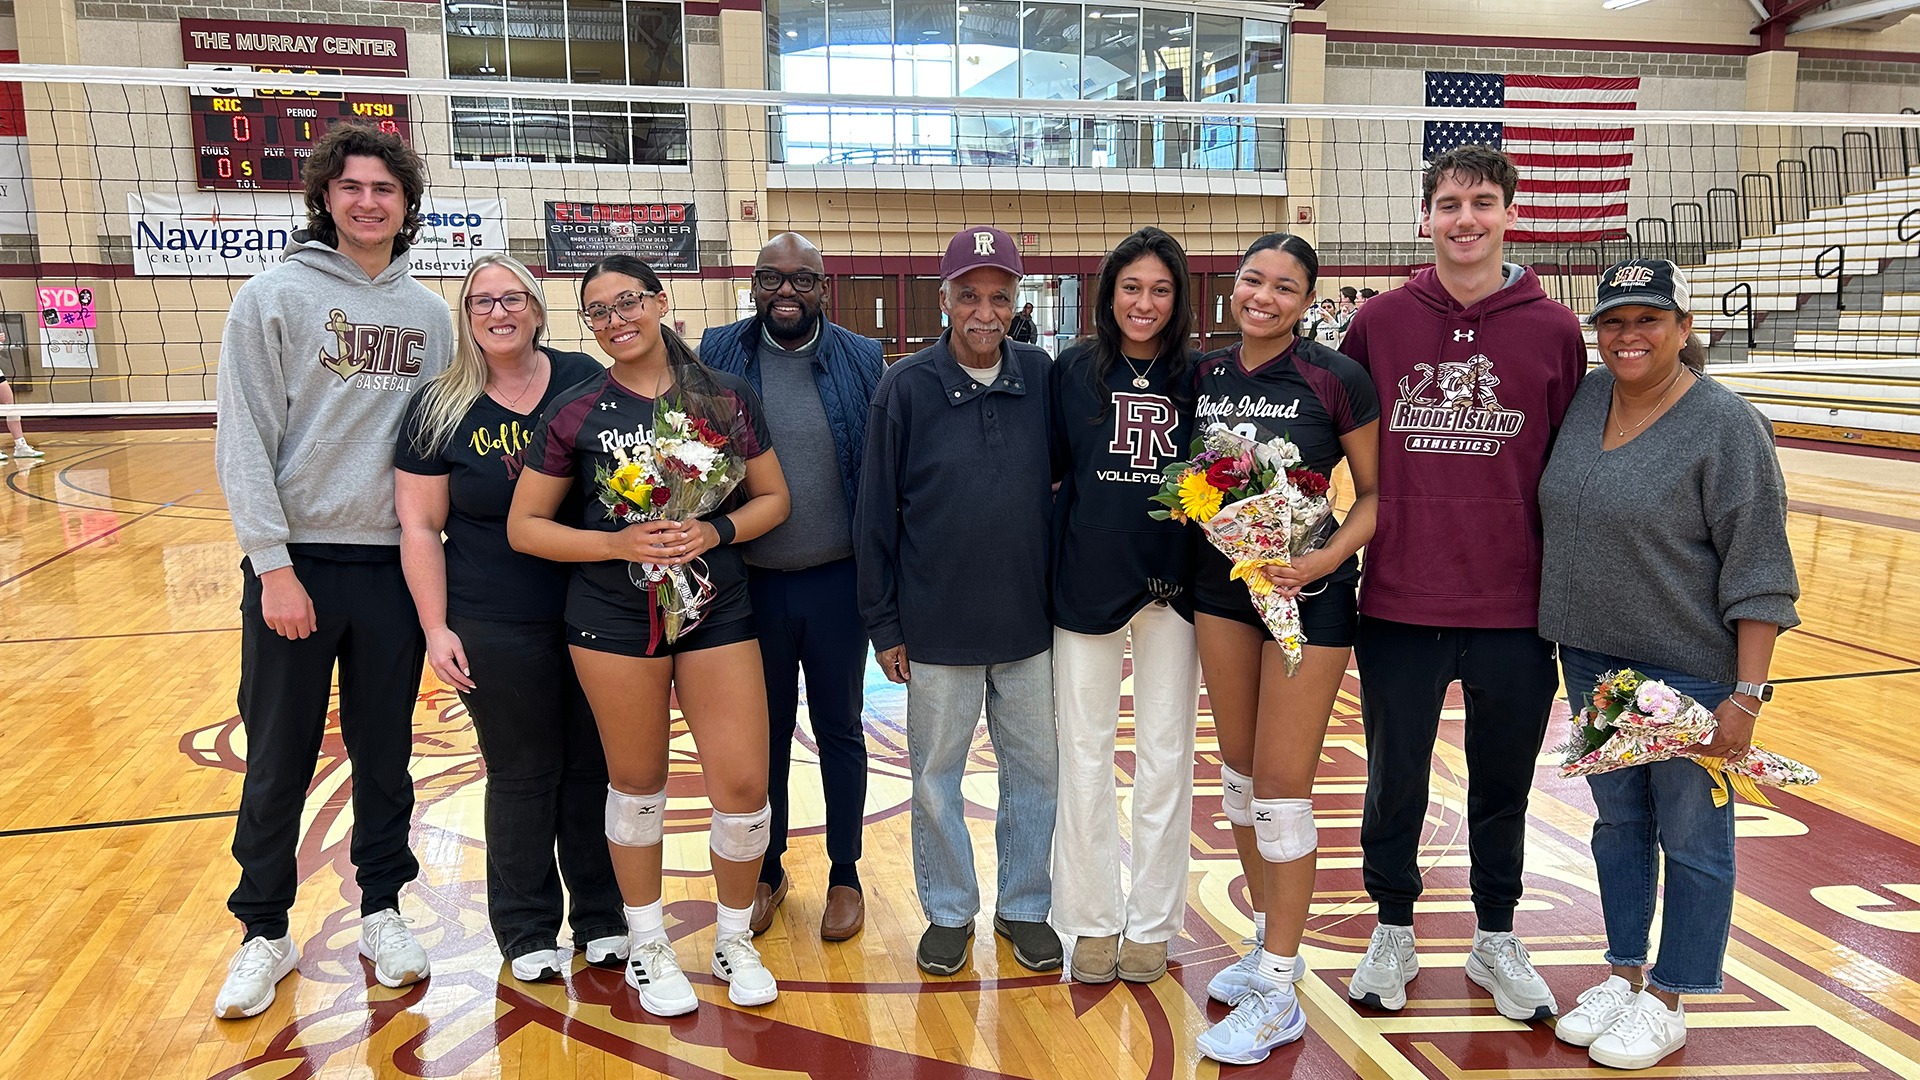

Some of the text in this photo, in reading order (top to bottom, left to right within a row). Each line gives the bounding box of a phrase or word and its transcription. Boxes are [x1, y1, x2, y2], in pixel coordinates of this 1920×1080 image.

[191, 32, 398, 57] THE MURRAY CENTER
[213, 98, 242, 113] RIC
[287, 108, 318, 118] PERIOD
[352, 103, 394, 117] VTSU
[232, 115, 250, 142] 0
[303, 121, 311, 140] 1
[201, 146, 230, 156] FOULS
[294, 149, 314, 157] FOU
[218, 158, 232, 178] 0
[555, 203, 686, 224] ELMWOOD
[137, 221, 298, 258] Navigan
[471, 234, 483, 246] G
[150, 254, 284, 263] CREDIT UNI
[40, 289, 79, 307] SYD
[63, 307, 91, 325] #22
[1325, 331, 1335, 341] 12
[346, 323, 427, 378] RIC
[356, 374, 416, 392] BASEBAL
[1195, 394, 1300, 419] Rhode Island
[1411, 438, 1492, 452] ATHLETICS
[1096, 470, 1168, 485] VOLLEYBA
